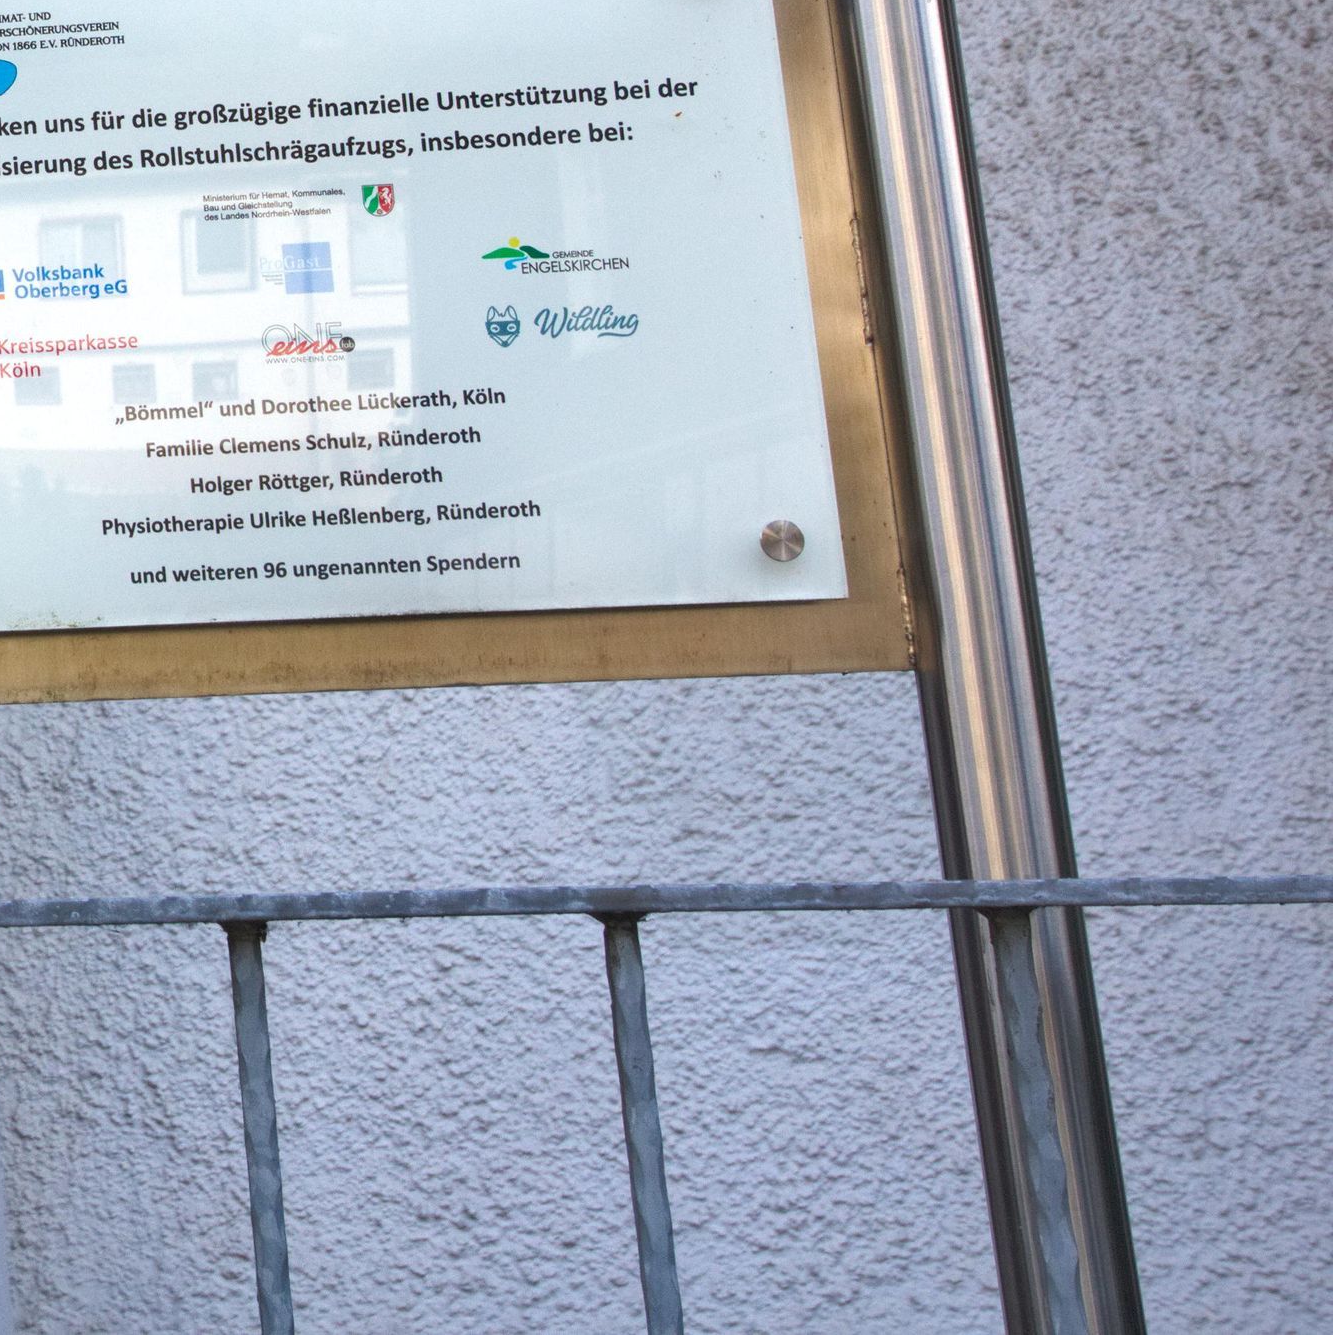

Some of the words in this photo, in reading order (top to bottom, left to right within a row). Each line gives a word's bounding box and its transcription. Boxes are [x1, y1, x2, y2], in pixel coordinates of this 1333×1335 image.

[28, 11, 52, 22] UND
[13, 40, 37, 51] 1866
[39, 39, 58, 50] E.V.
[59, 34, 126, 48] RÜNDEROTH
[44, 115, 86, 135] uns
[90, 109, 126, 132] für
[131, 106, 168, 130] die
[173, 99, 302, 132] großzügige
[306, 91, 430, 120] finanzielle
[436, 84, 609, 113] Unterstützung
[612, 78, 652, 102] bei
[657, 75, 699, 100] der
[92, 148, 134, 172] des
[139, 135, 414, 170] Rollstuhlschrägaufzugs,
[419, 123, 582, 154] insbesondere
[587, 119, 634, 145] bei:
[203, 192, 248, 203] Ministerium
[249, 191, 260, 201] für
[291, 187, 346, 198] Kommunales,
[203, 203, 220, 213] Bau
[221, 202, 236, 212] und
[238, 199, 293, 211] Gleichstellung
[204, 212, 219, 222] des
[220, 210, 250, 221] Landes
[251, 207, 332, 220] Nordrhein-Westfalen
[12, 263, 105, 283] Volksbank
[521, 257, 630, 275] ENGELSKIRCHEN
[14, 282, 100, 300] Oberberg
[104, 279, 128, 295] eG
[534, 304, 640, 339] Wildling
[0, 361, 42, 379] Köln
[219, 397, 256, 419] und
[261, 395, 353, 417] Dorothee
[357, 388, 458, 412] Lückerath,
[462, 385, 507, 407] Köln
[145, 437, 214, 459] Familie
[219, 436, 301, 456] Clemens
[305, 431, 373, 452] Schulz,
[377, 424, 482, 449] Ründeroth
[189, 474, 254, 498] Holger
[258, 472, 335, 494] Röttger,
[339, 464, 444, 489] Ründeroth
[101, 511, 245, 539] Physiotherapie
[249, 509, 307, 530] Ulrike
[311, 505, 432, 528] Heßlenberg,
[436, 498, 542, 523] Ründeroth
[129, 564, 168, 586] und
[171, 564, 259, 584] weiteren
[262, 560, 288, 580] 96
[292, 556, 422, 582] ungenannten
[426, 551, 521, 576] Spendern
